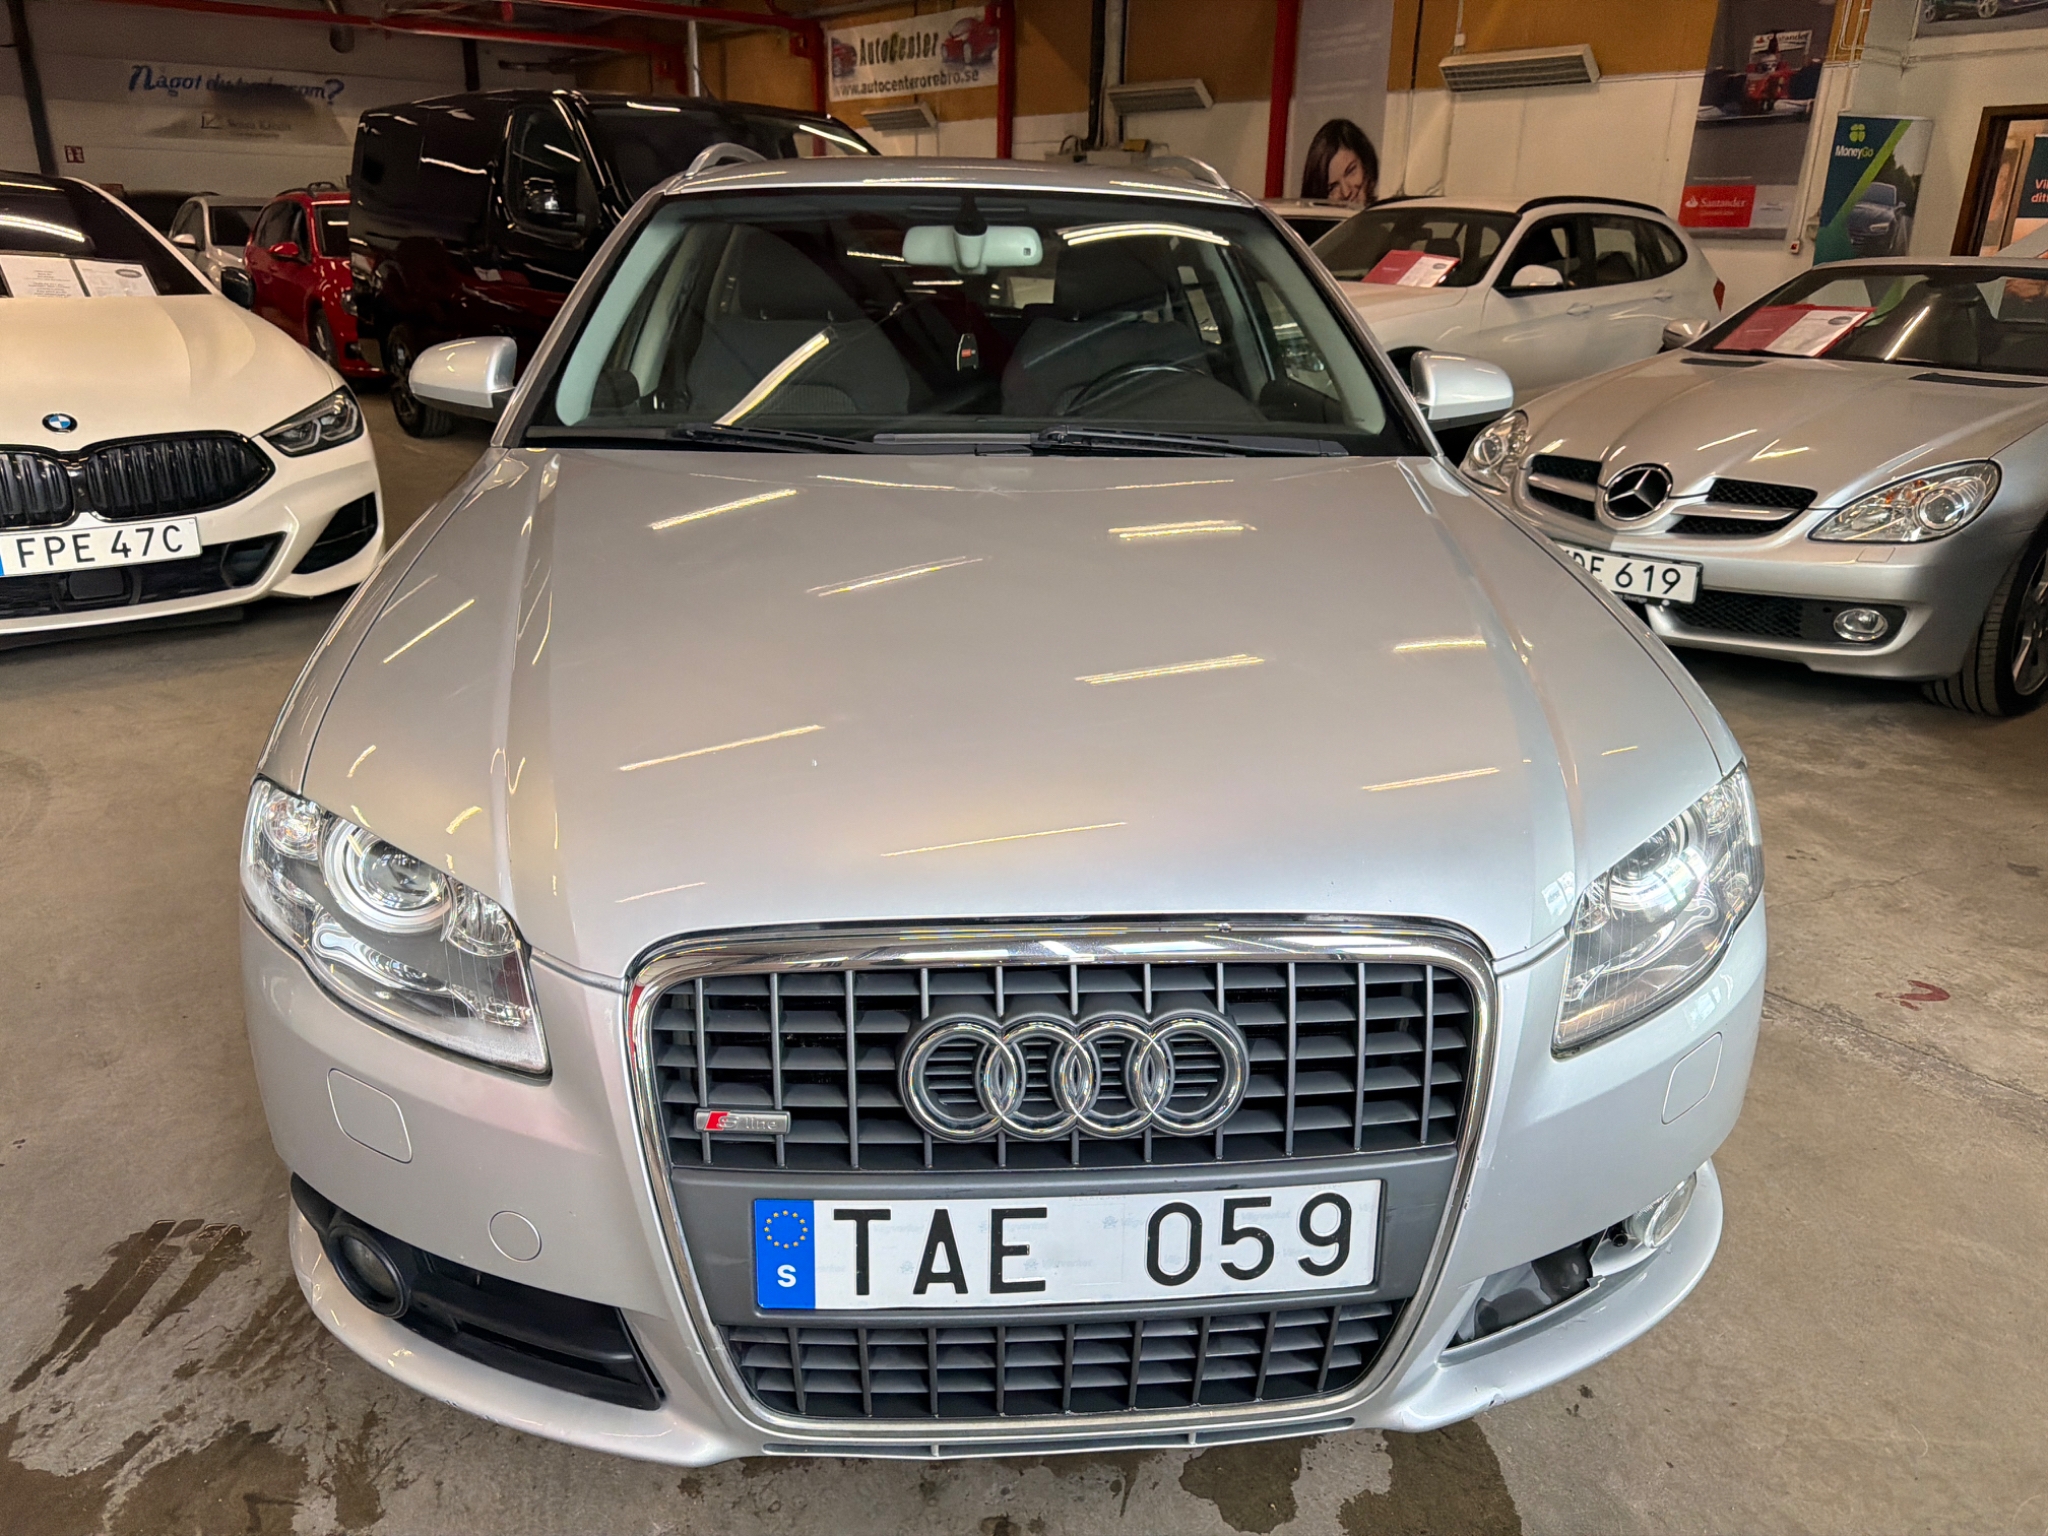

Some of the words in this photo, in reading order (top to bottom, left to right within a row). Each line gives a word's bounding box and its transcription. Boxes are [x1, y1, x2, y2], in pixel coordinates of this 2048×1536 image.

[860, 31, 939, 66] AutoCenter
[835, 69, 980, 97] www.autocenterorebro.se
[1835, 145, 1873, 159] MoneyGo
[1700, 196, 1746, 208] Santander
[16, 533, 96, 569] FPE
[111, 524, 183, 558] 47C
[1615, 561, 1682, 595] 619
[832, 1206, 1049, 1296] TAE
[1145, 1191, 1353, 1288] 059
[776, 1264, 798, 1288] S
